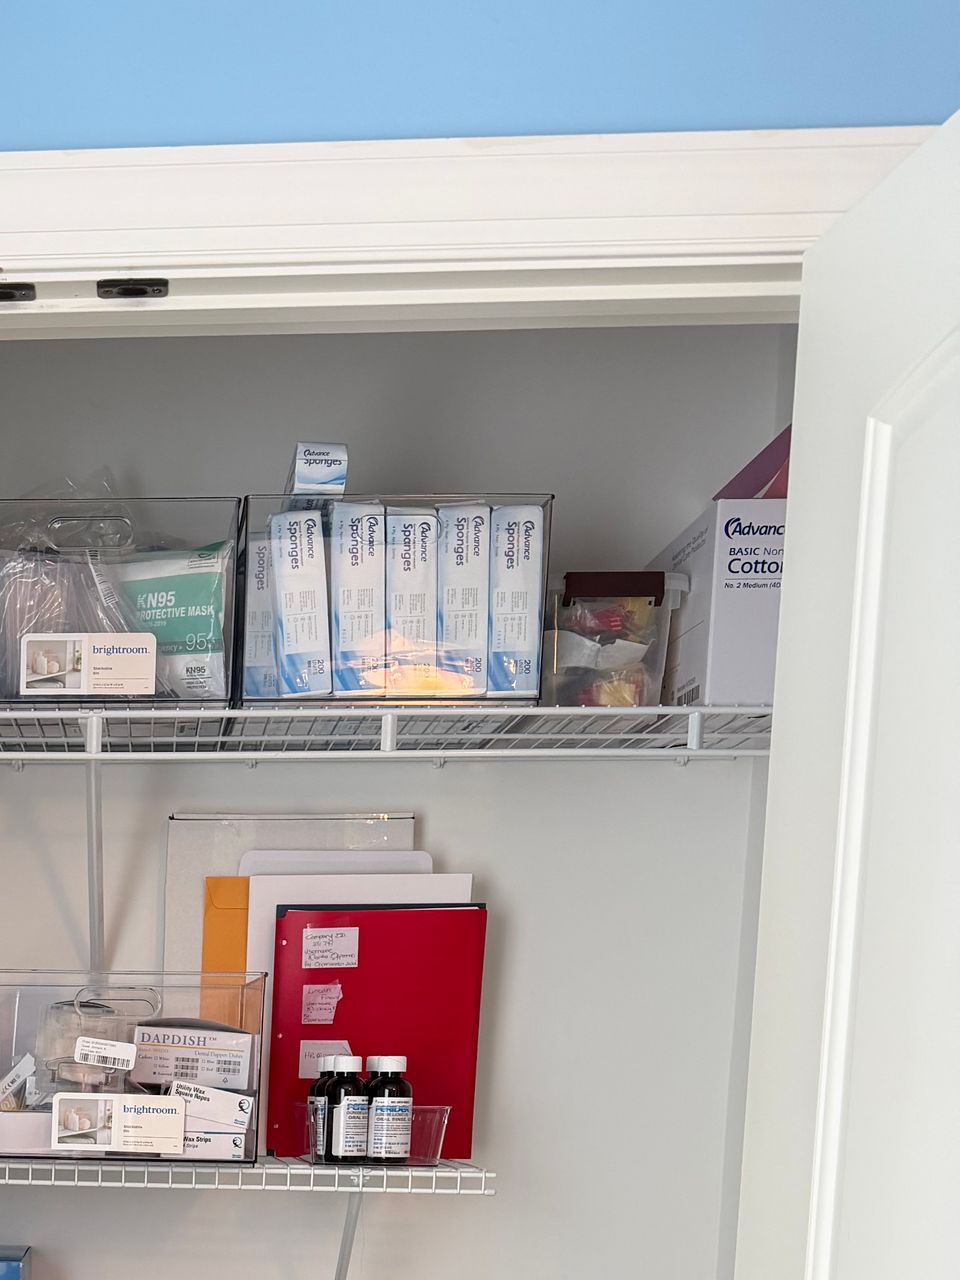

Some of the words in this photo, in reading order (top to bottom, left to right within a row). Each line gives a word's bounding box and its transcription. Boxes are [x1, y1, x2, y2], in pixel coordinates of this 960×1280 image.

[304, 518, 315, 559] Advance
[366, 515, 378, 557] Advance
[473, 516, 485, 557] Advance
[724, 517, 785, 539] Advanc
[289, 521, 300, 570] Sponges
[350, 517, 360, 567] Sponges
[456, 517, 467, 567] Sponges
[506, 521, 518, 570] Sponges
[523, 520, 535, 561] Advance
[729, 547, 760, 555] BASIC
[137, 591, 175, 609] KN95
[137, 606, 185, 621] PROTECTIVE
[188, 605, 214, 616] MASK
[92, 645, 148, 656] brightroom
[186, 666, 206, 675] KN95
[175, 1089, 193, 1098] Square
[176, 1084, 192, 1092] Utility
[193, 1087, 205, 1095] Wax
[123, 1105, 177, 1115] brightroom
